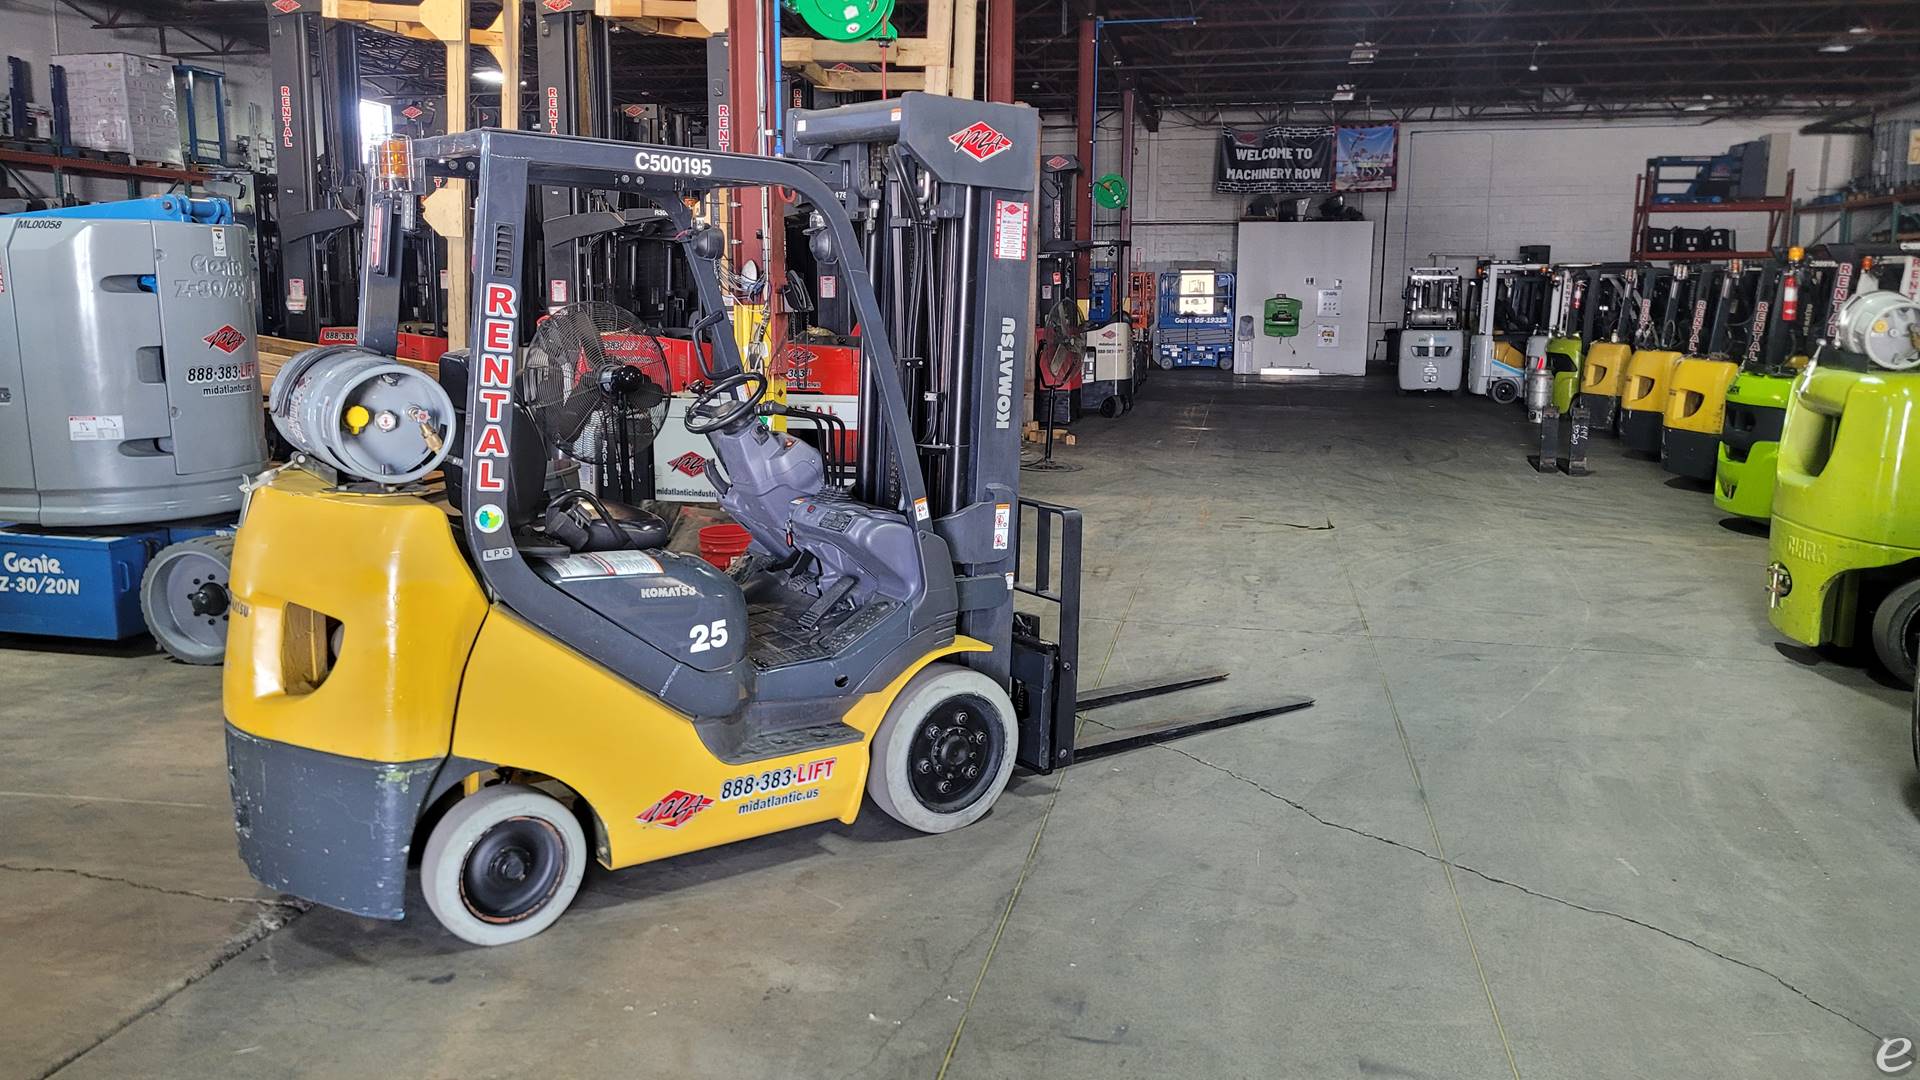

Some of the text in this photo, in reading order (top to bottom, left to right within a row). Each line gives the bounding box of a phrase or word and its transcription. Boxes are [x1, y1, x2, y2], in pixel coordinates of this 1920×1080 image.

[281, 86, 292, 147] RENTAL
[635, 152, 712, 176] C500195
[1236, 147, 1313, 161] WELCOME TO
[1226, 168, 1322, 180] MACHINERY ROW
[18, 220, 63, 230] ML00058
[1749, 302, 1768, 361] RENTAL
[996, 317, 1016, 429] KOMATSU
[476, 284, 517, 491] RENTAL
[3, 552, 62, 574] Genie
[0, 575, 80, 595] Z-30/20N
[641, 585, 697, 599] KOMATSU
[689, 618, 729, 654] 25
[738, 788, 819, 815] midatlantic.us
